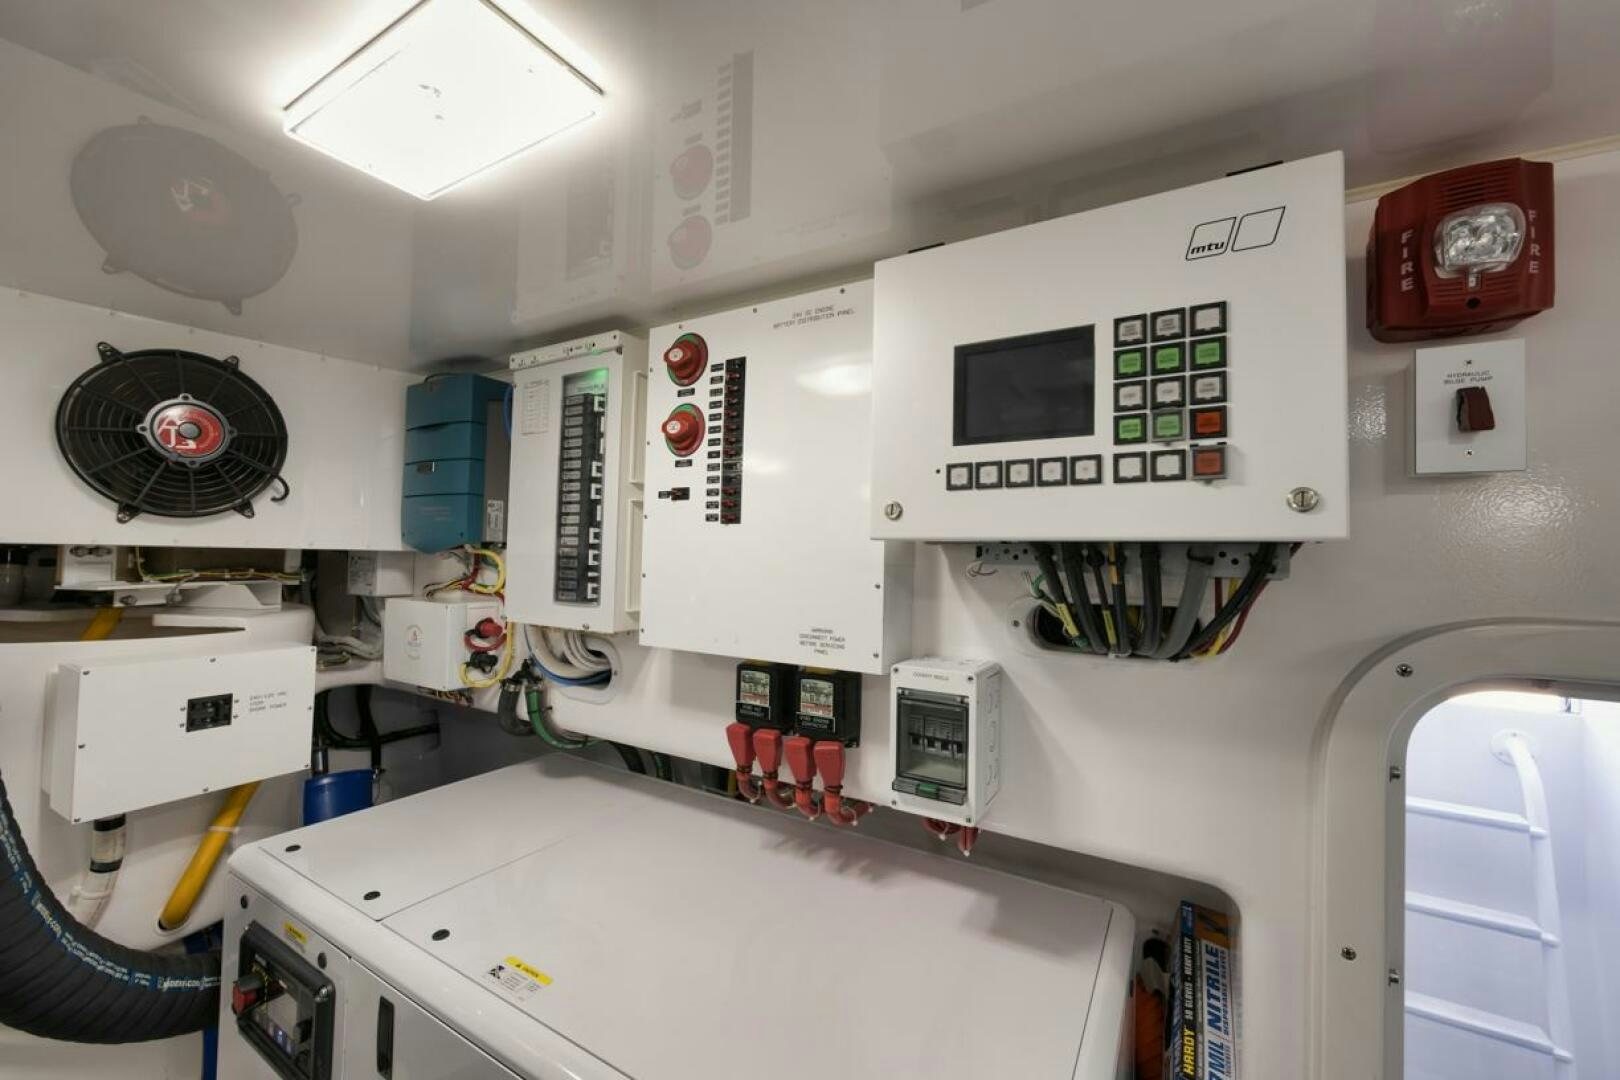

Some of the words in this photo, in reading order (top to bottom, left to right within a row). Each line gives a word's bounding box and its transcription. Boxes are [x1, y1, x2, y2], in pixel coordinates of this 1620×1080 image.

[1190, 241, 1225, 255] mtu
[1528, 209, 1541, 275] FIRE
[1400, 229, 1415, 293] FIRE
[837, 308, 855, 317] PANEL
[1446, 369, 1490, 378] HYDRAULIC
[1470, 375, 1494, 383] PUMP
[1184, 937, 1193, 954] DUTY
[1184, 954, 1193, 976] HEAVY
[1184, 981, 1194, 1009] GLOVES
[1206, 944, 1223, 1032] NITRILE
[1182, 1028, 1195, 1075] HARDY
